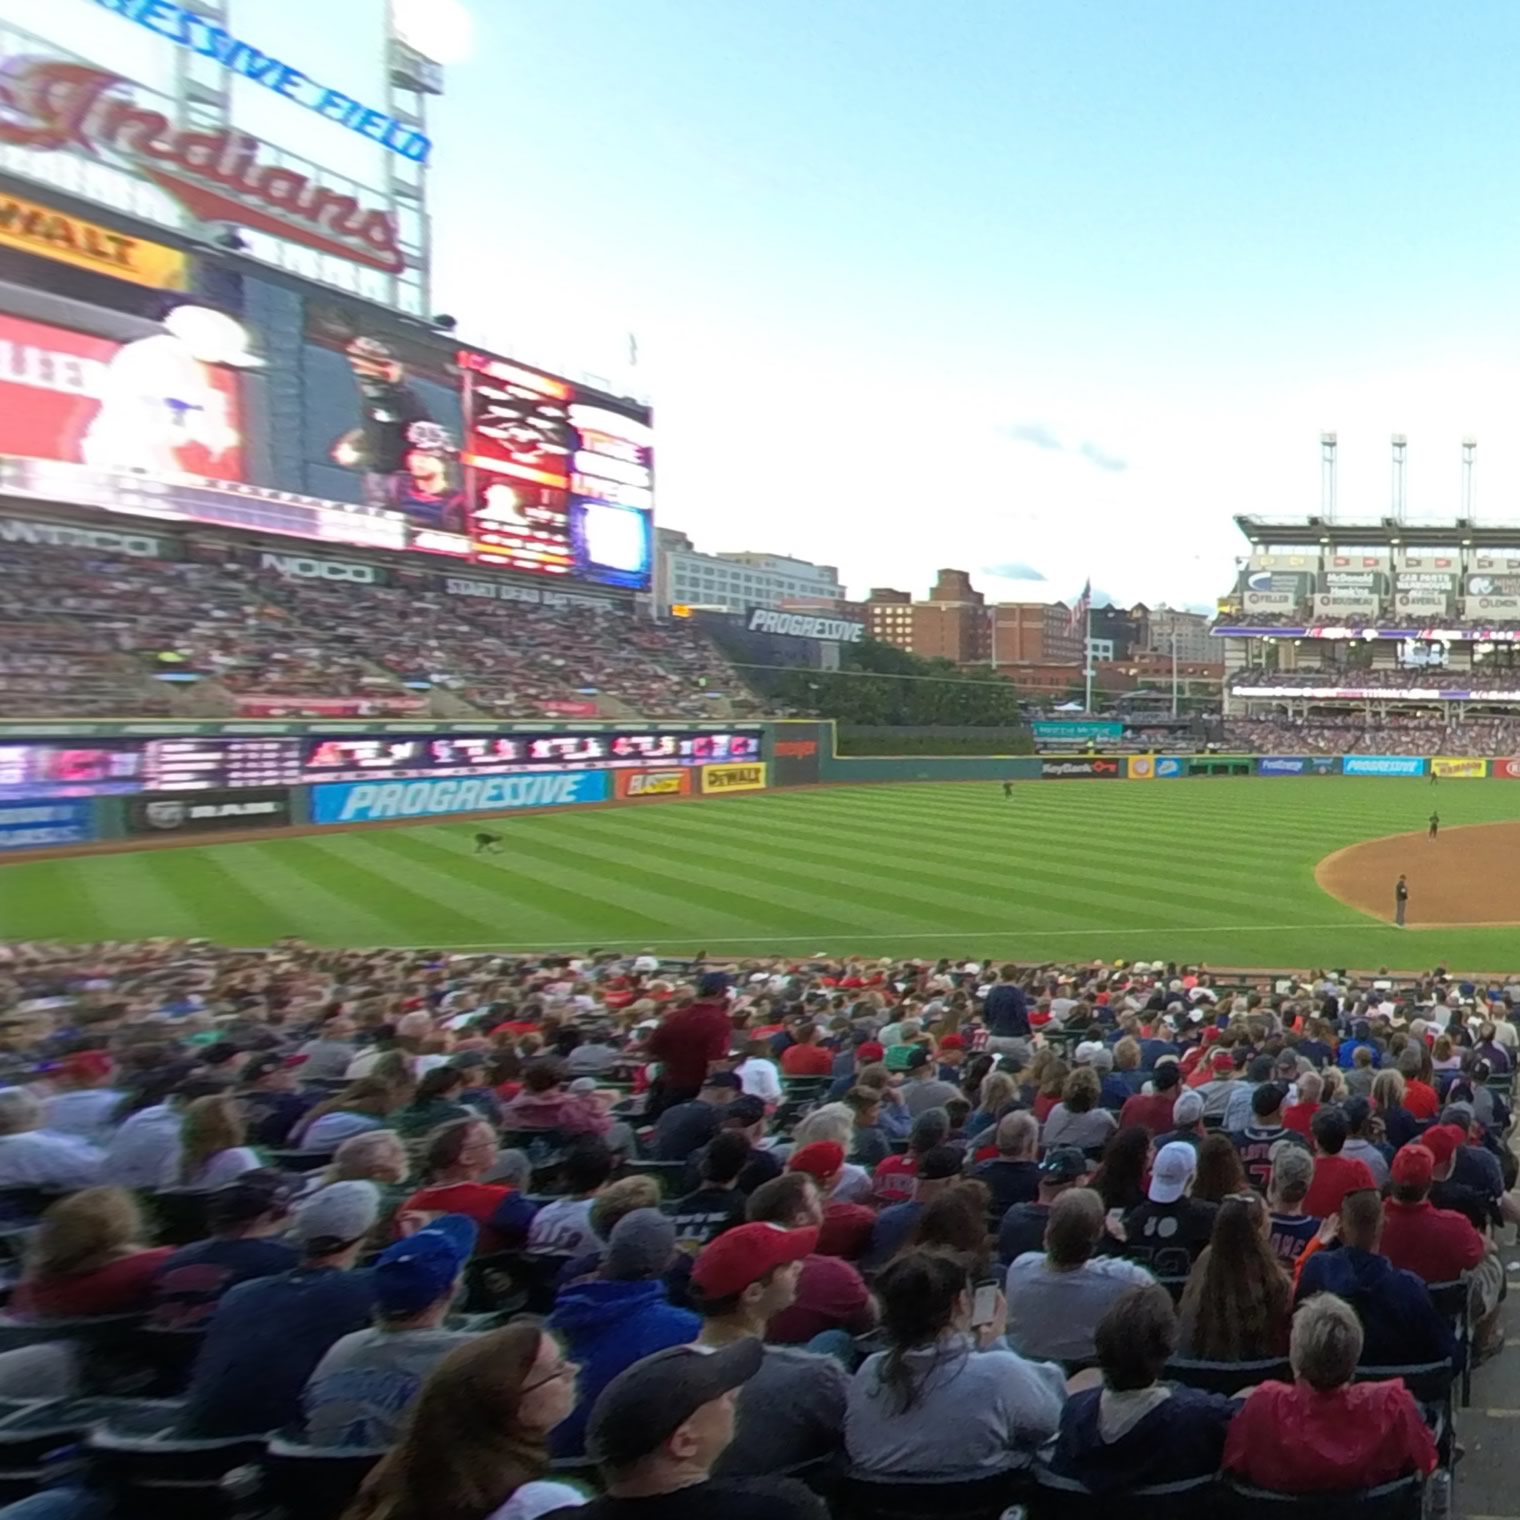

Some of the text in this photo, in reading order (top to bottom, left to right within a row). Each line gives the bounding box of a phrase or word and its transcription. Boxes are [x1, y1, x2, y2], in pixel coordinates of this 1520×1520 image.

[312, 88, 432, 163] FIELD
[0, 60, 402, 262] Indians
[1327, 572, 1373, 582] McDonald
[1420, 574, 1449, 582] PARTS
[1396, 582, 1452, 590] WAREHOUSE
[748, 609, 865, 642] PROGRESSIVE
[1042, 762, 1092, 775] KeyBank
[1346, 760, 1418, 773] PROGRESSIVE
[338, 774, 588, 820] PROGRESSIVE
